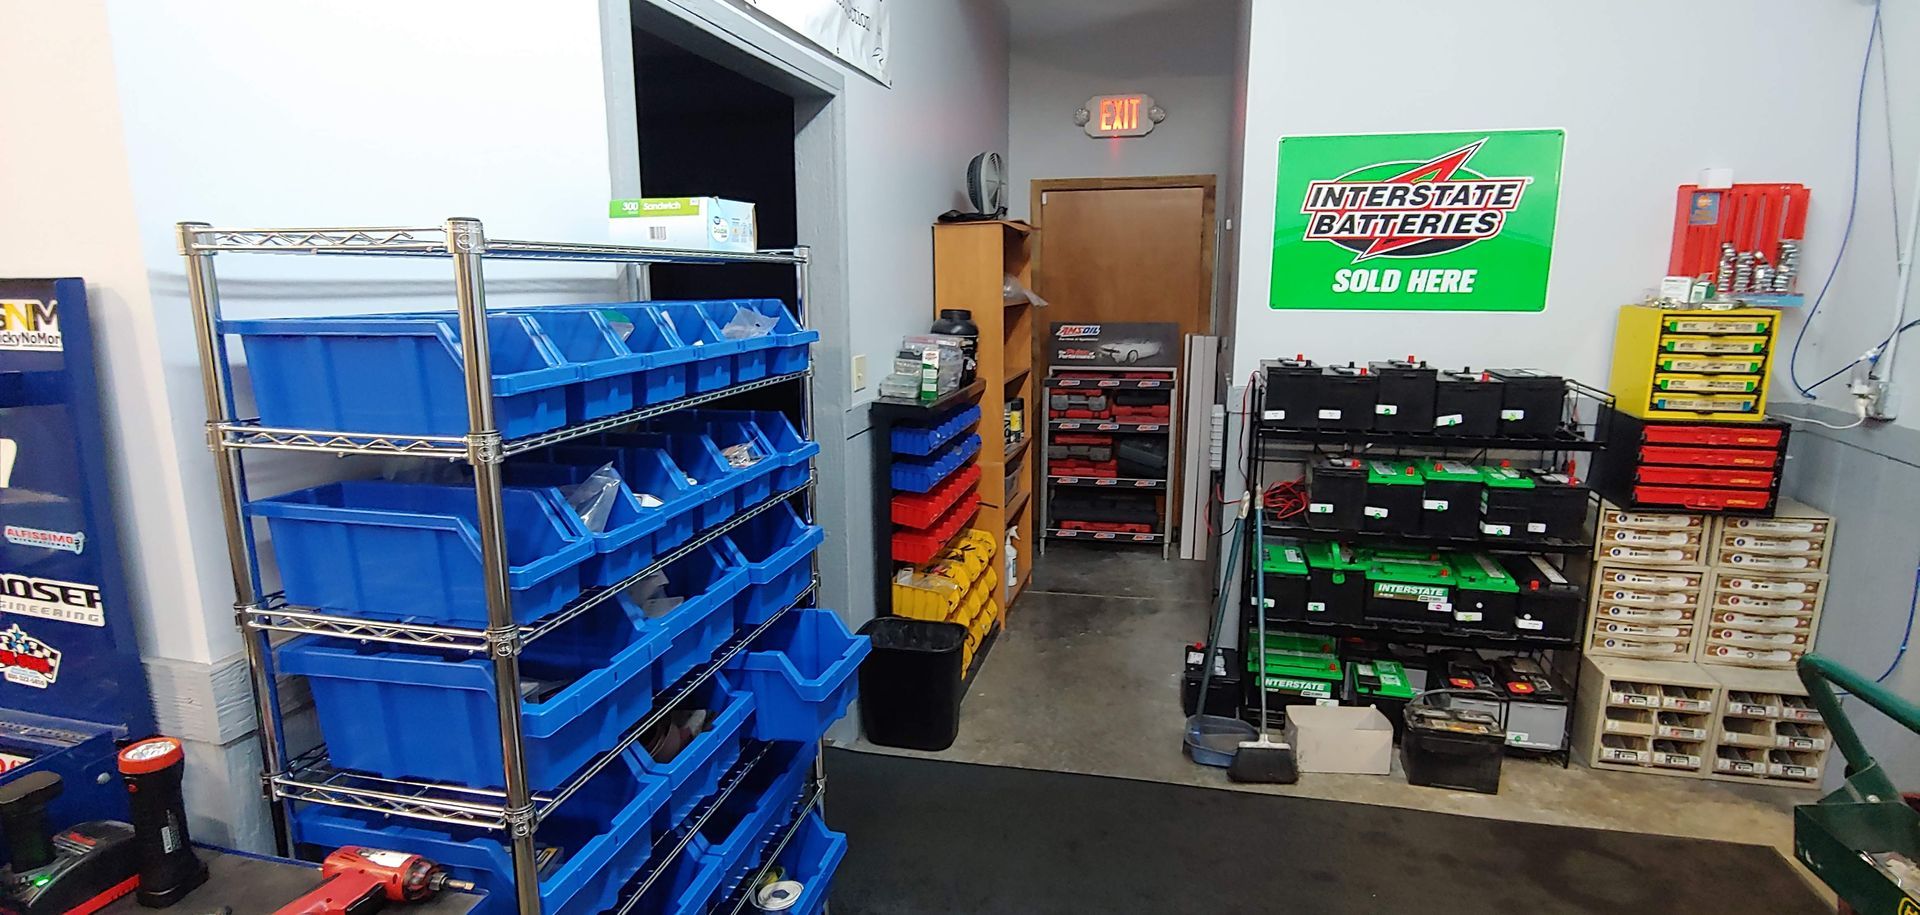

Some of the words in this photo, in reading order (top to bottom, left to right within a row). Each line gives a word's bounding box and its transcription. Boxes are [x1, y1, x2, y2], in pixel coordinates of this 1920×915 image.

[1101, 98, 1141, 130] EXIT
[1310, 183, 1518, 208] INTERSTATE
[622, 202, 639, 211] 300
[643, 201, 681, 211] Sandwich
[1313, 211, 1498, 235] BATTERIES
[1331, 268, 1401, 293] SOLD
[1406, 268, 1478, 293] HERE
[7, 528, 74, 545] ALFISSIMO
[1378, 582, 1444, 596] INTERSTATE
[1264, 677, 1325, 691] NTERSTATE
